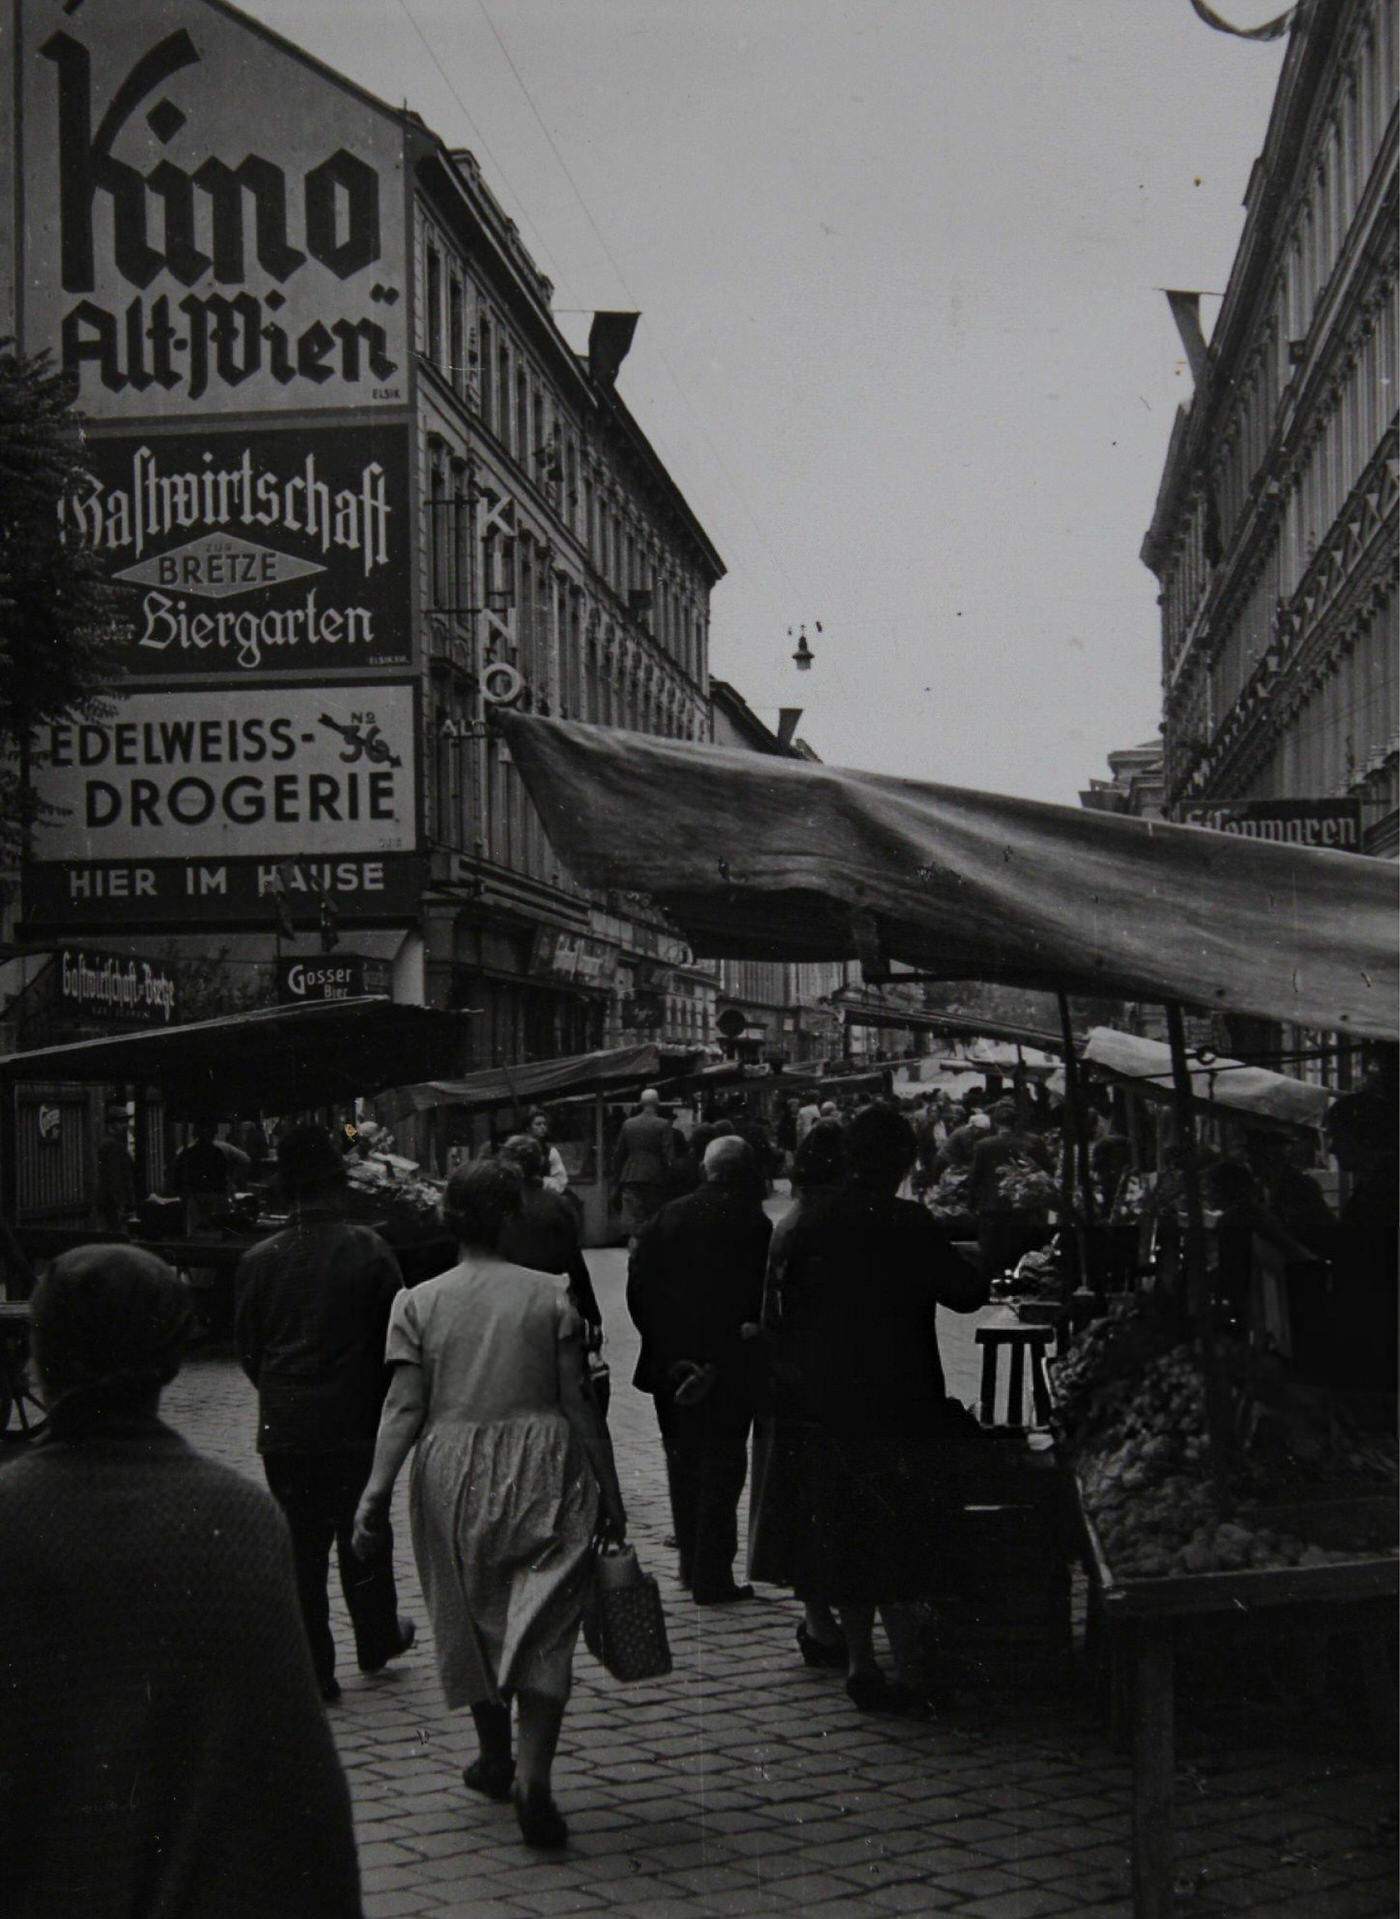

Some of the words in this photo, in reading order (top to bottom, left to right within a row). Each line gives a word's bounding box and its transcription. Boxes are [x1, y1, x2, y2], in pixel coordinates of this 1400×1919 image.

[38, 28, 382, 293] Kino
[160, 553, 277, 584] BRETZE
[476, 497, 523, 703] KINO
[138, 588, 375, 668] Biergarten
[51, 718, 315, 767] EDELWEISS-
[86, 772, 393, 828] DROGERIE
[70, 868, 157, 897] HIER
[186, 866, 227, 895] IM
[257, 862, 385, 893] HAUSE
[324, 984, 349, 998] Bier
